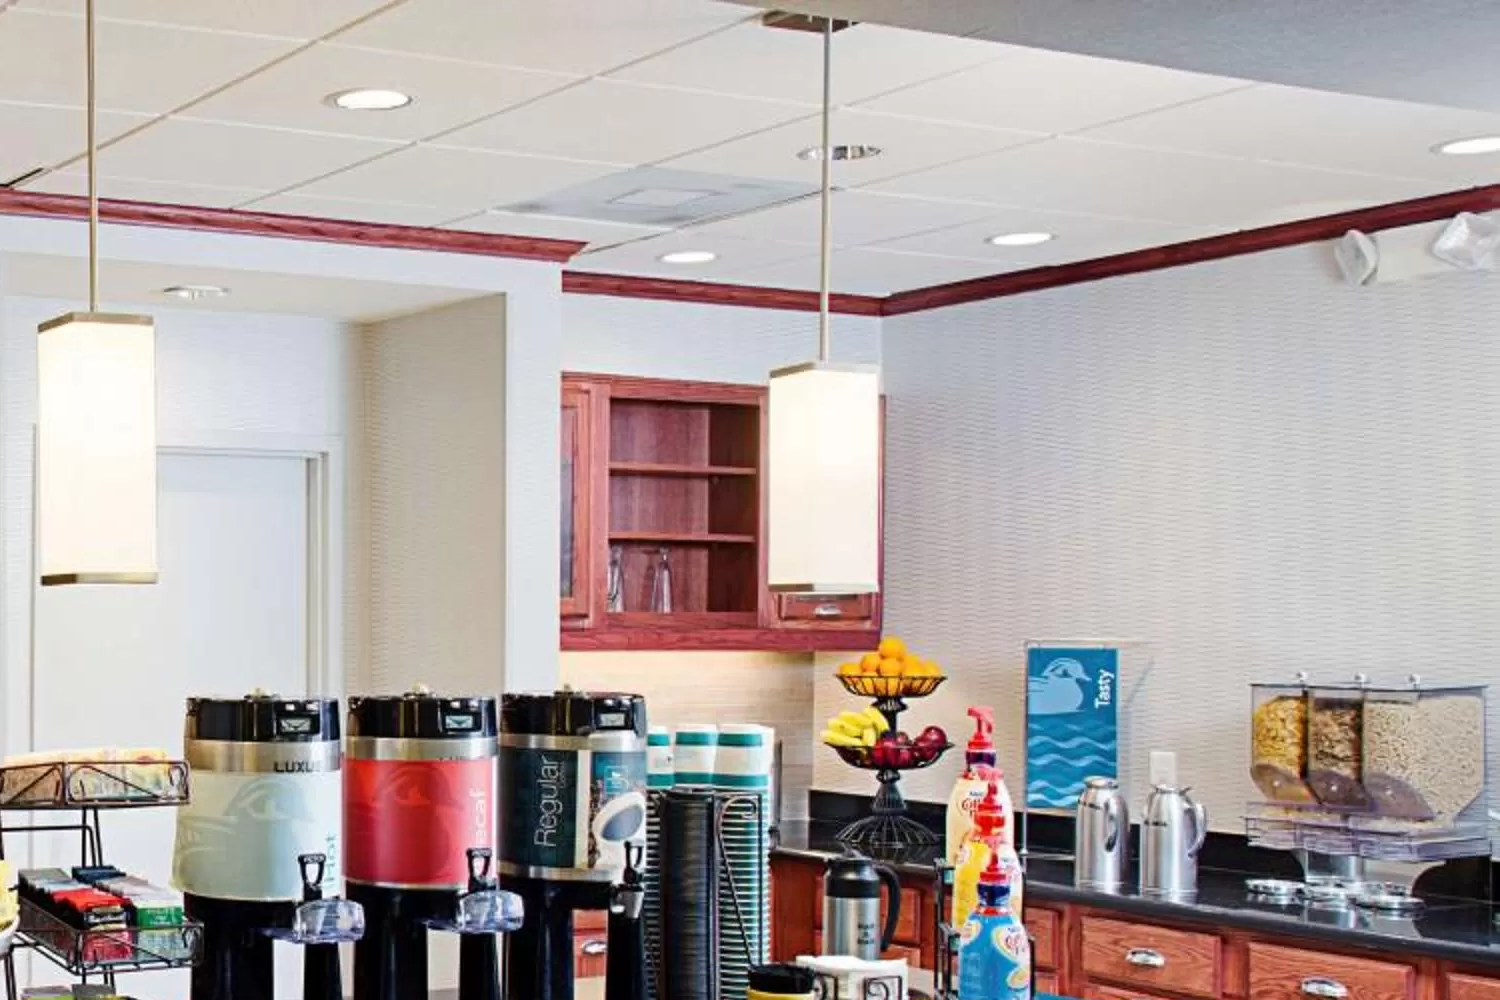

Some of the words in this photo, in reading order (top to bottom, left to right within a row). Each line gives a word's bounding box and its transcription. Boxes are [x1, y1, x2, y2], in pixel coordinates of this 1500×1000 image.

[1094, 669, 1115, 709] Tasty
[469, 786, 486, 849] ecaf
[534, 754, 564, 847] Regular
